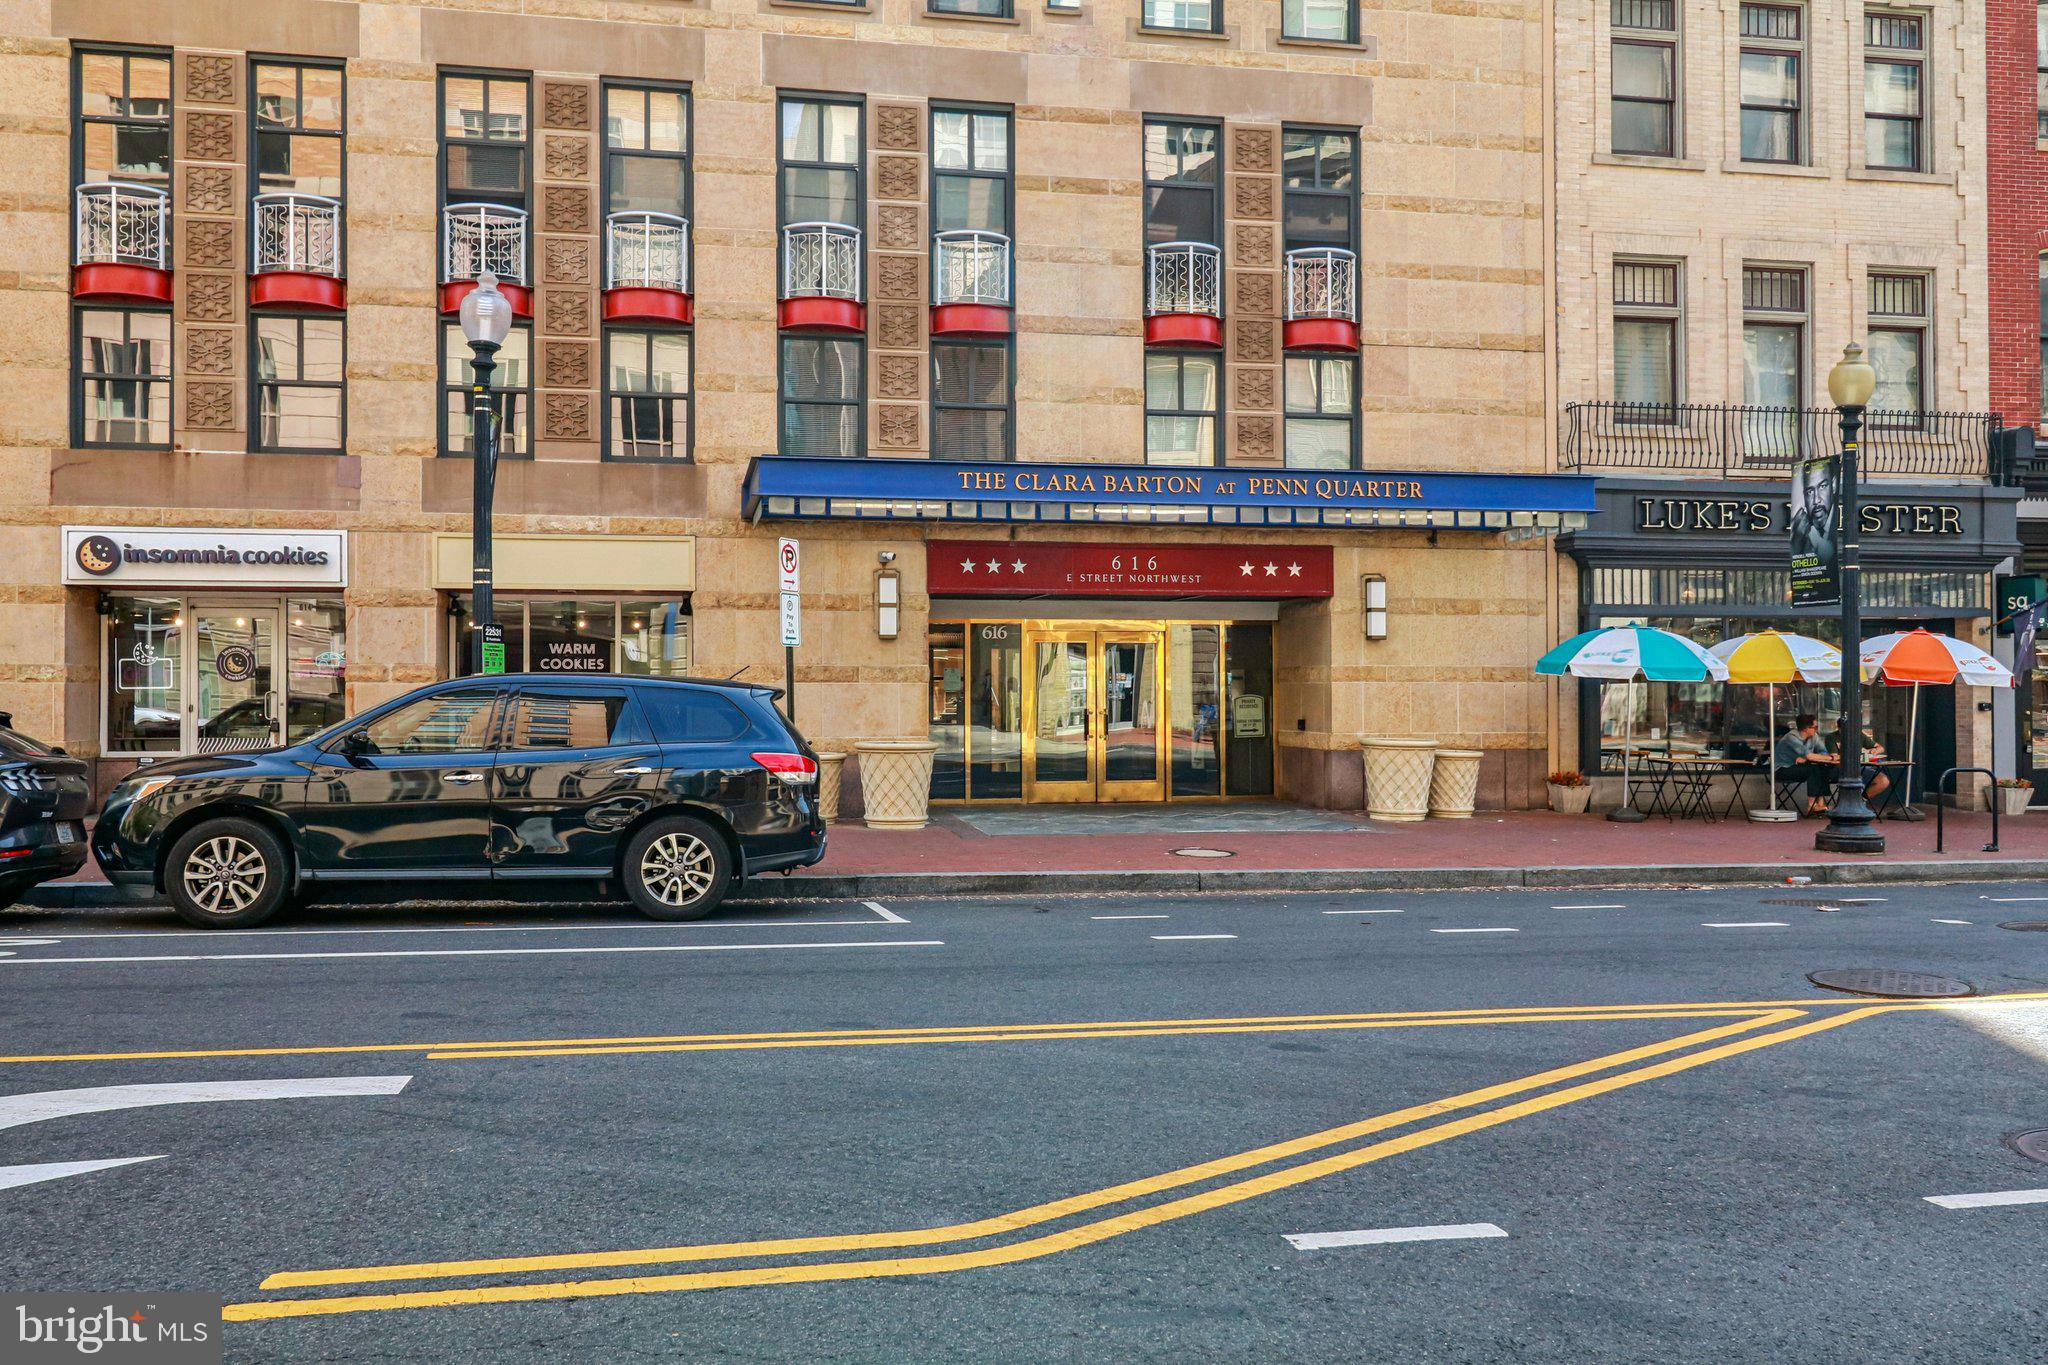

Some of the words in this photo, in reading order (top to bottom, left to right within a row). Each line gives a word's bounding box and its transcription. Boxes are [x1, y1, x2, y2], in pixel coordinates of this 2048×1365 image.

[957, 471, 1007, 490] THE
[1014, 473, 1097, 492] CLARA
[1103, 475, 1202, 494] BARTON
[1215, 481, 1236, 495] AT
[1248, 477, 1309, 497] PENN
[1315, 478, 1424, 500] QUARTER
[1640, 499, 1772, 531] LUKE'S
[123, 543, 242, 564] insomnia
[242, 545, 329, 566] cookies
[1791, 557, 1818, 568] OTHELLO
[1066, 573, 1073, 582] E
[1079, 573, 1124, 583] STREET
[1128, 574, 1202, 584] NORTHWEST
[786, 613, 794, 621] Pay
[982, 625, 1008, 640] 616
[548, 643, 596, 655] WARM
[540, 658, 605, 670] COOKIES
